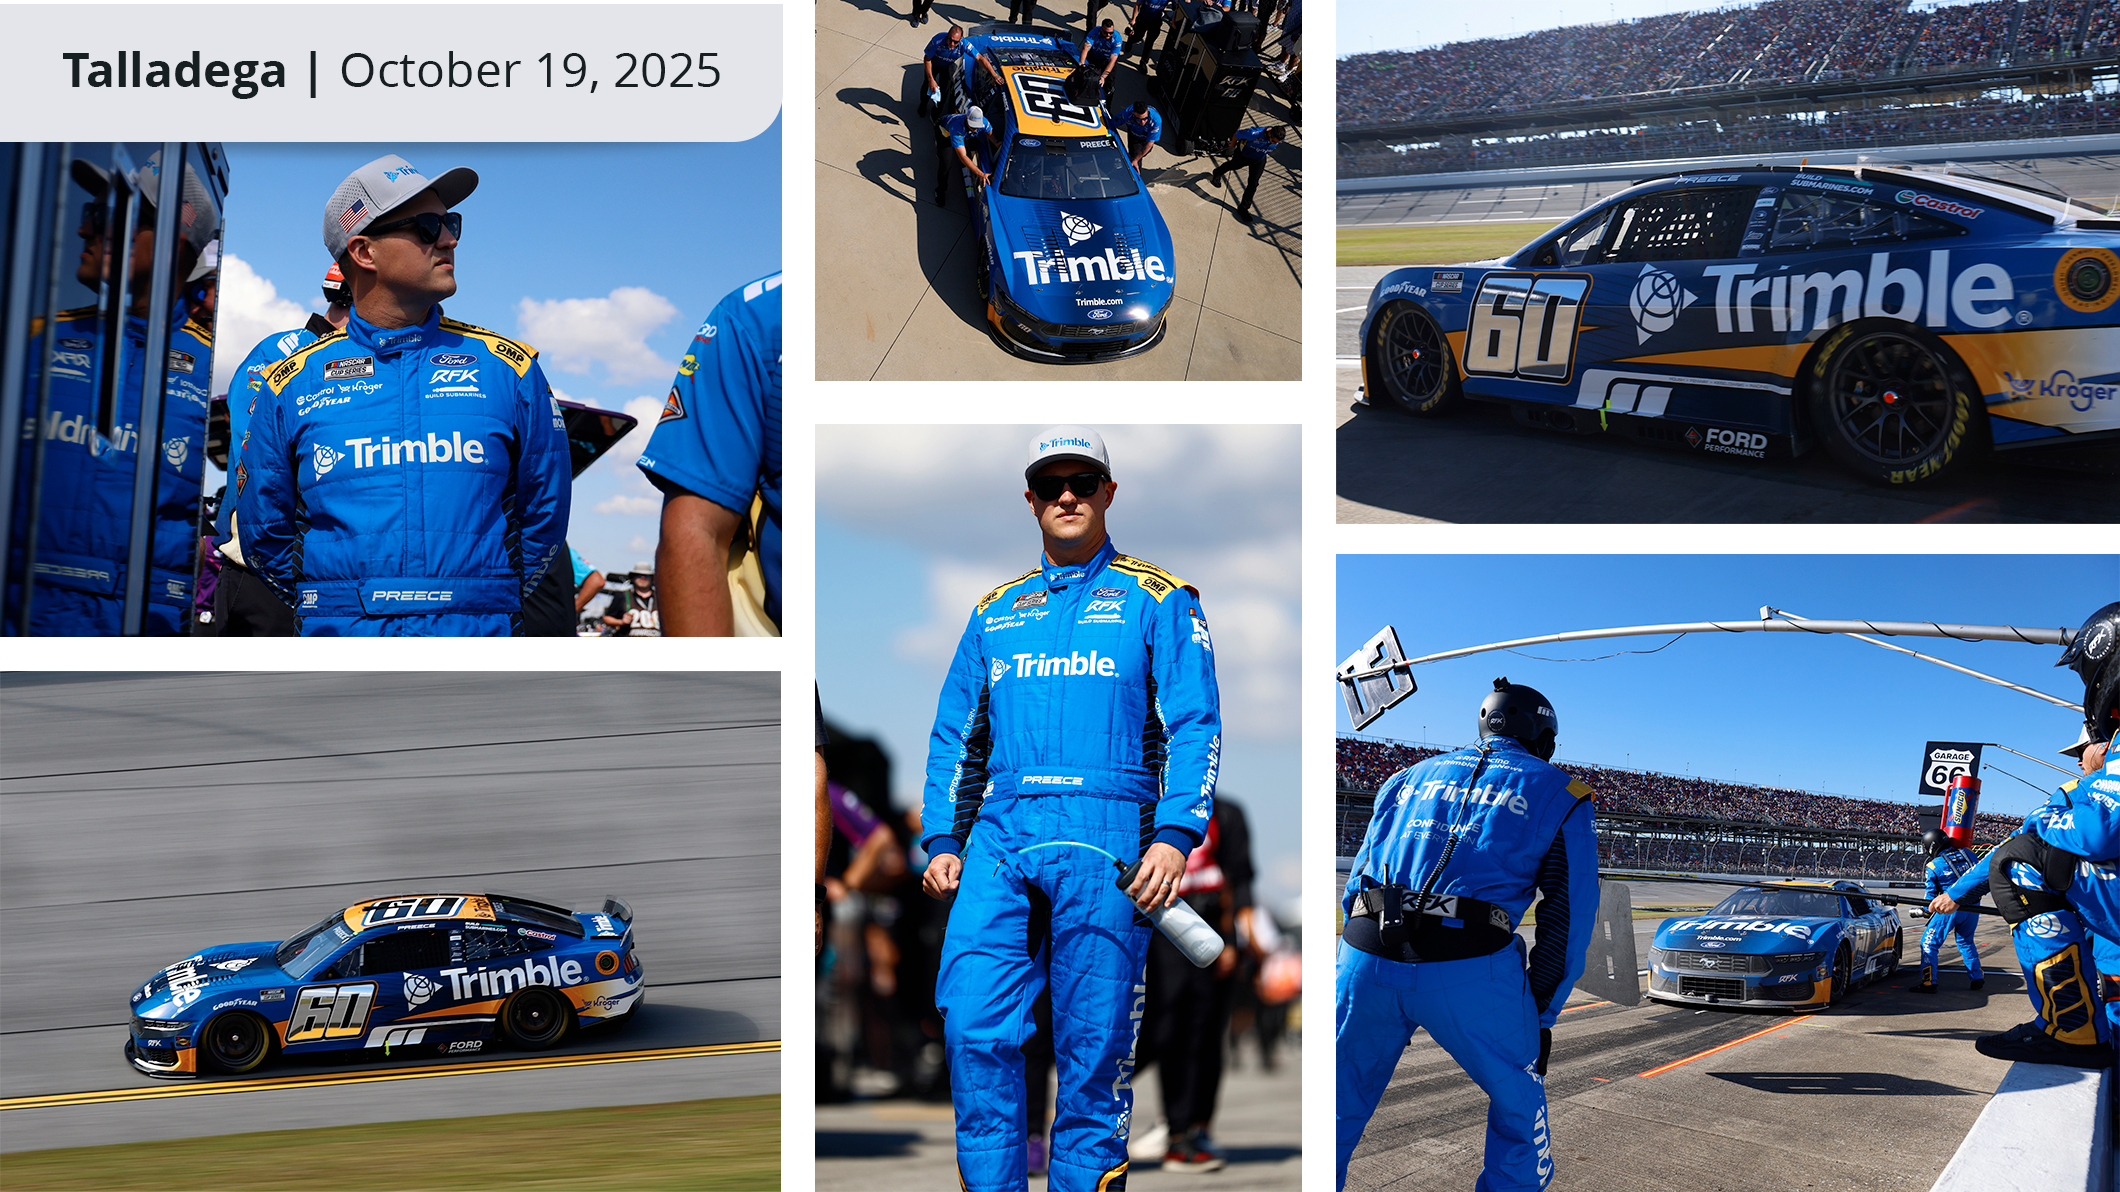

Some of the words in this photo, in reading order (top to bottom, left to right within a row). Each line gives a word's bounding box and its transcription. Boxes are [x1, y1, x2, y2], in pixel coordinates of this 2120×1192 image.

[1080, 140, 1111, 149] PREECE
[1675, 174, 1742, 185] PREECE
[1795, 173, 1823, 181] BUILD
[1790, 179, 1875, 196] SUBMARINES.COM
[1914, 191, 1981, 220] Castrol
[1013, 248, 1166, 286] Trimble
[1380, 281, 1427, 298] GOODYEAR
[1702, 249, 2015, 333] Trimble
[1075, 298, 1123, 306] Trimble.com
[1092, 310, 1108, 319] Ford
[1467, 277, 1588, 378] 60
[438, 353, 467, 365] Ford
[496, 343, 525, 363] OMP
[273, 361, 297, 385] OMP
[429, 369, 480, 384] RFK
[352, 380, 383, 395] Kroger
[2039, 369, 2119, 412] Kroger
[298, 396, 351, 416] GOODYEAR
[1049, 437, 1091, 449] Trimble
[1705, 427, 1769, 450] FORD
[345, 431, 485, 469] Trimble
[1704, 443, 1766, 459] PERFORMANCE
[1056, 570, 1086, 580] Trimble
[1096, 587, 1119, 597] Ford
[1143, 577, 1167, 593] OMP
[372, 590, 453, 602] PREECE
[1084, 600, 1127, 612] RFK
[1027, 608, 1051, 621] Kroger
[1012, 650, 1115, 679] Trimble
[1934, 752, 1970, 761] GARAGE
[1199, 735, 1221, 799] Trimble
[1022, 775, 1084, 786] PREECE
[1421, 779, 1529, 816] Trimble
[1954, 791, 1965, 823] SUNOCO
[1400, 831, 1413, 839] AT
[397, 923, 436, 931] PREECE
[1668, 920, 1812, 940] Trimble
[526, 929, 557, 941] Castrol
[440, 955, 583, 1001] Trimble
[1778, 973, 1798, 984] RFK
[213, 997, 258, 1011] GOODYEAR
[593, 996, 620, 1011] Kroger
[290, 984, 376, 1041] 60
[449, 1040, 483, 1050] FORD
